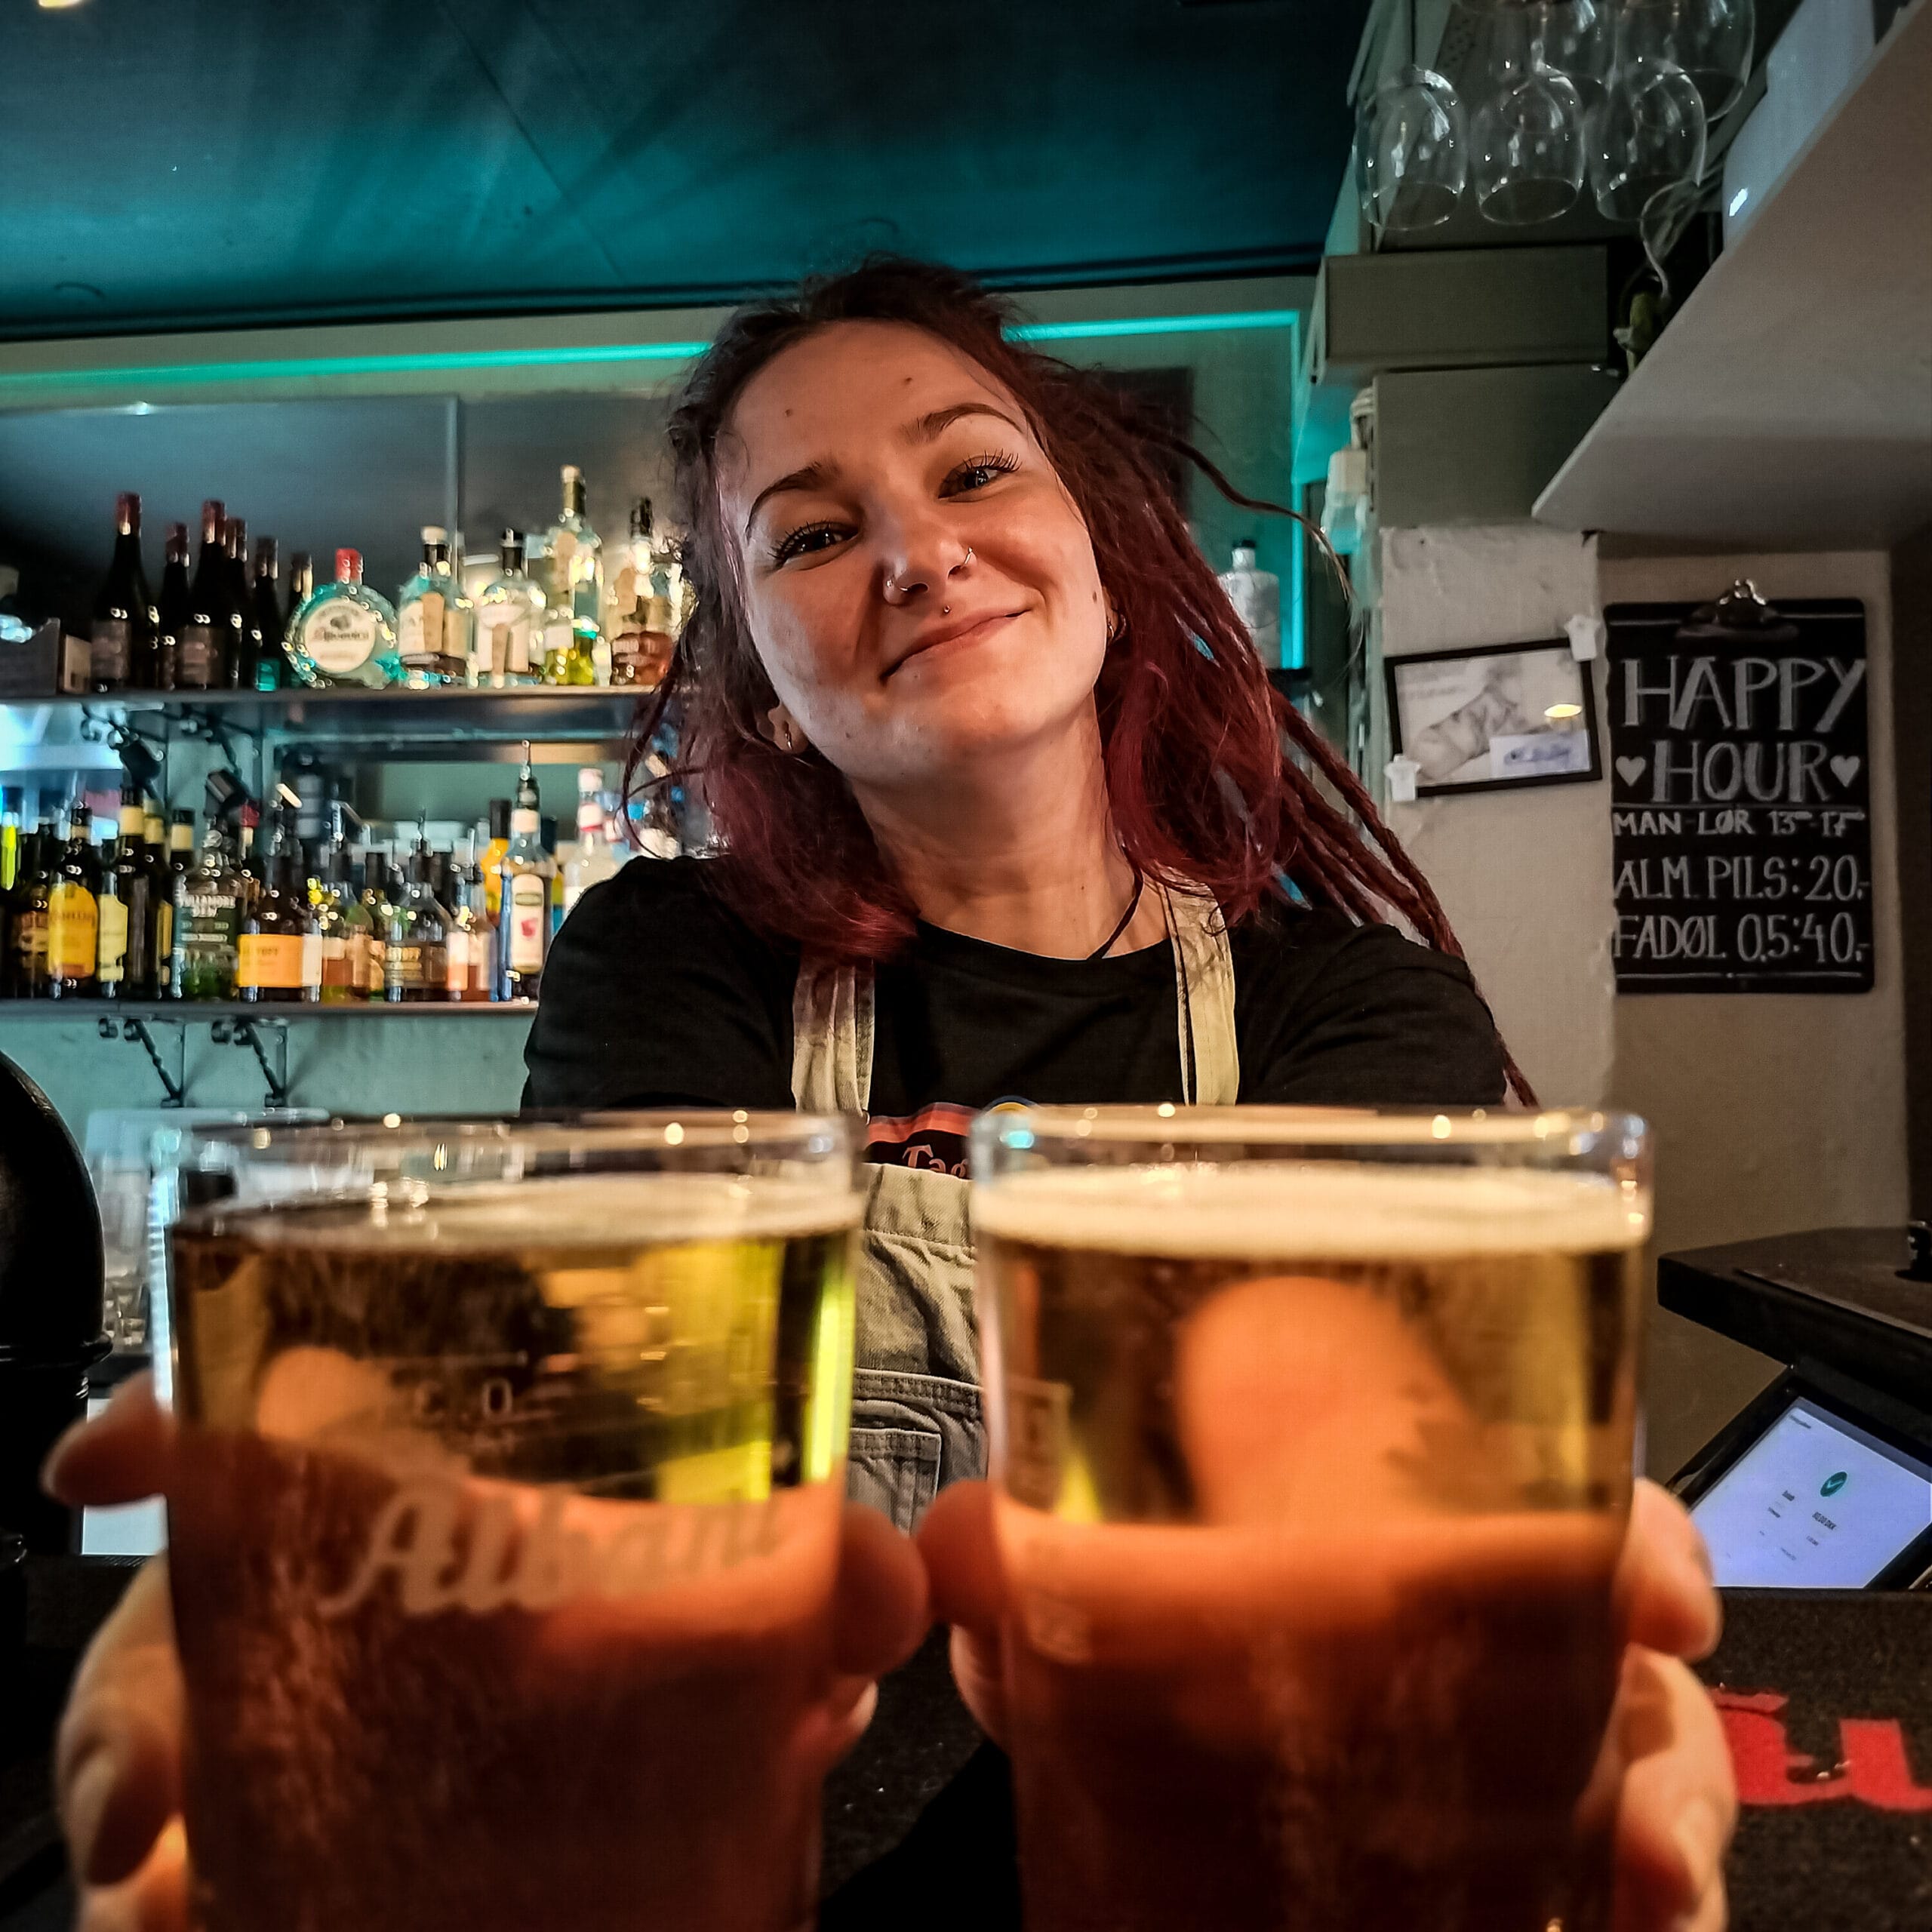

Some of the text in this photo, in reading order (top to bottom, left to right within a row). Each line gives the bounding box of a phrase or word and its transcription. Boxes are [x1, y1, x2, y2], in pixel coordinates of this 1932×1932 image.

[1622, 655, 1866, 732] HAPPY
[1652, 740, 1831, 802] HOUR
[1613, 811, 1681, 836] MAN
[1614, 855, 1691, 899] ALM
[1613, 914, 1727, 959] FADØL
